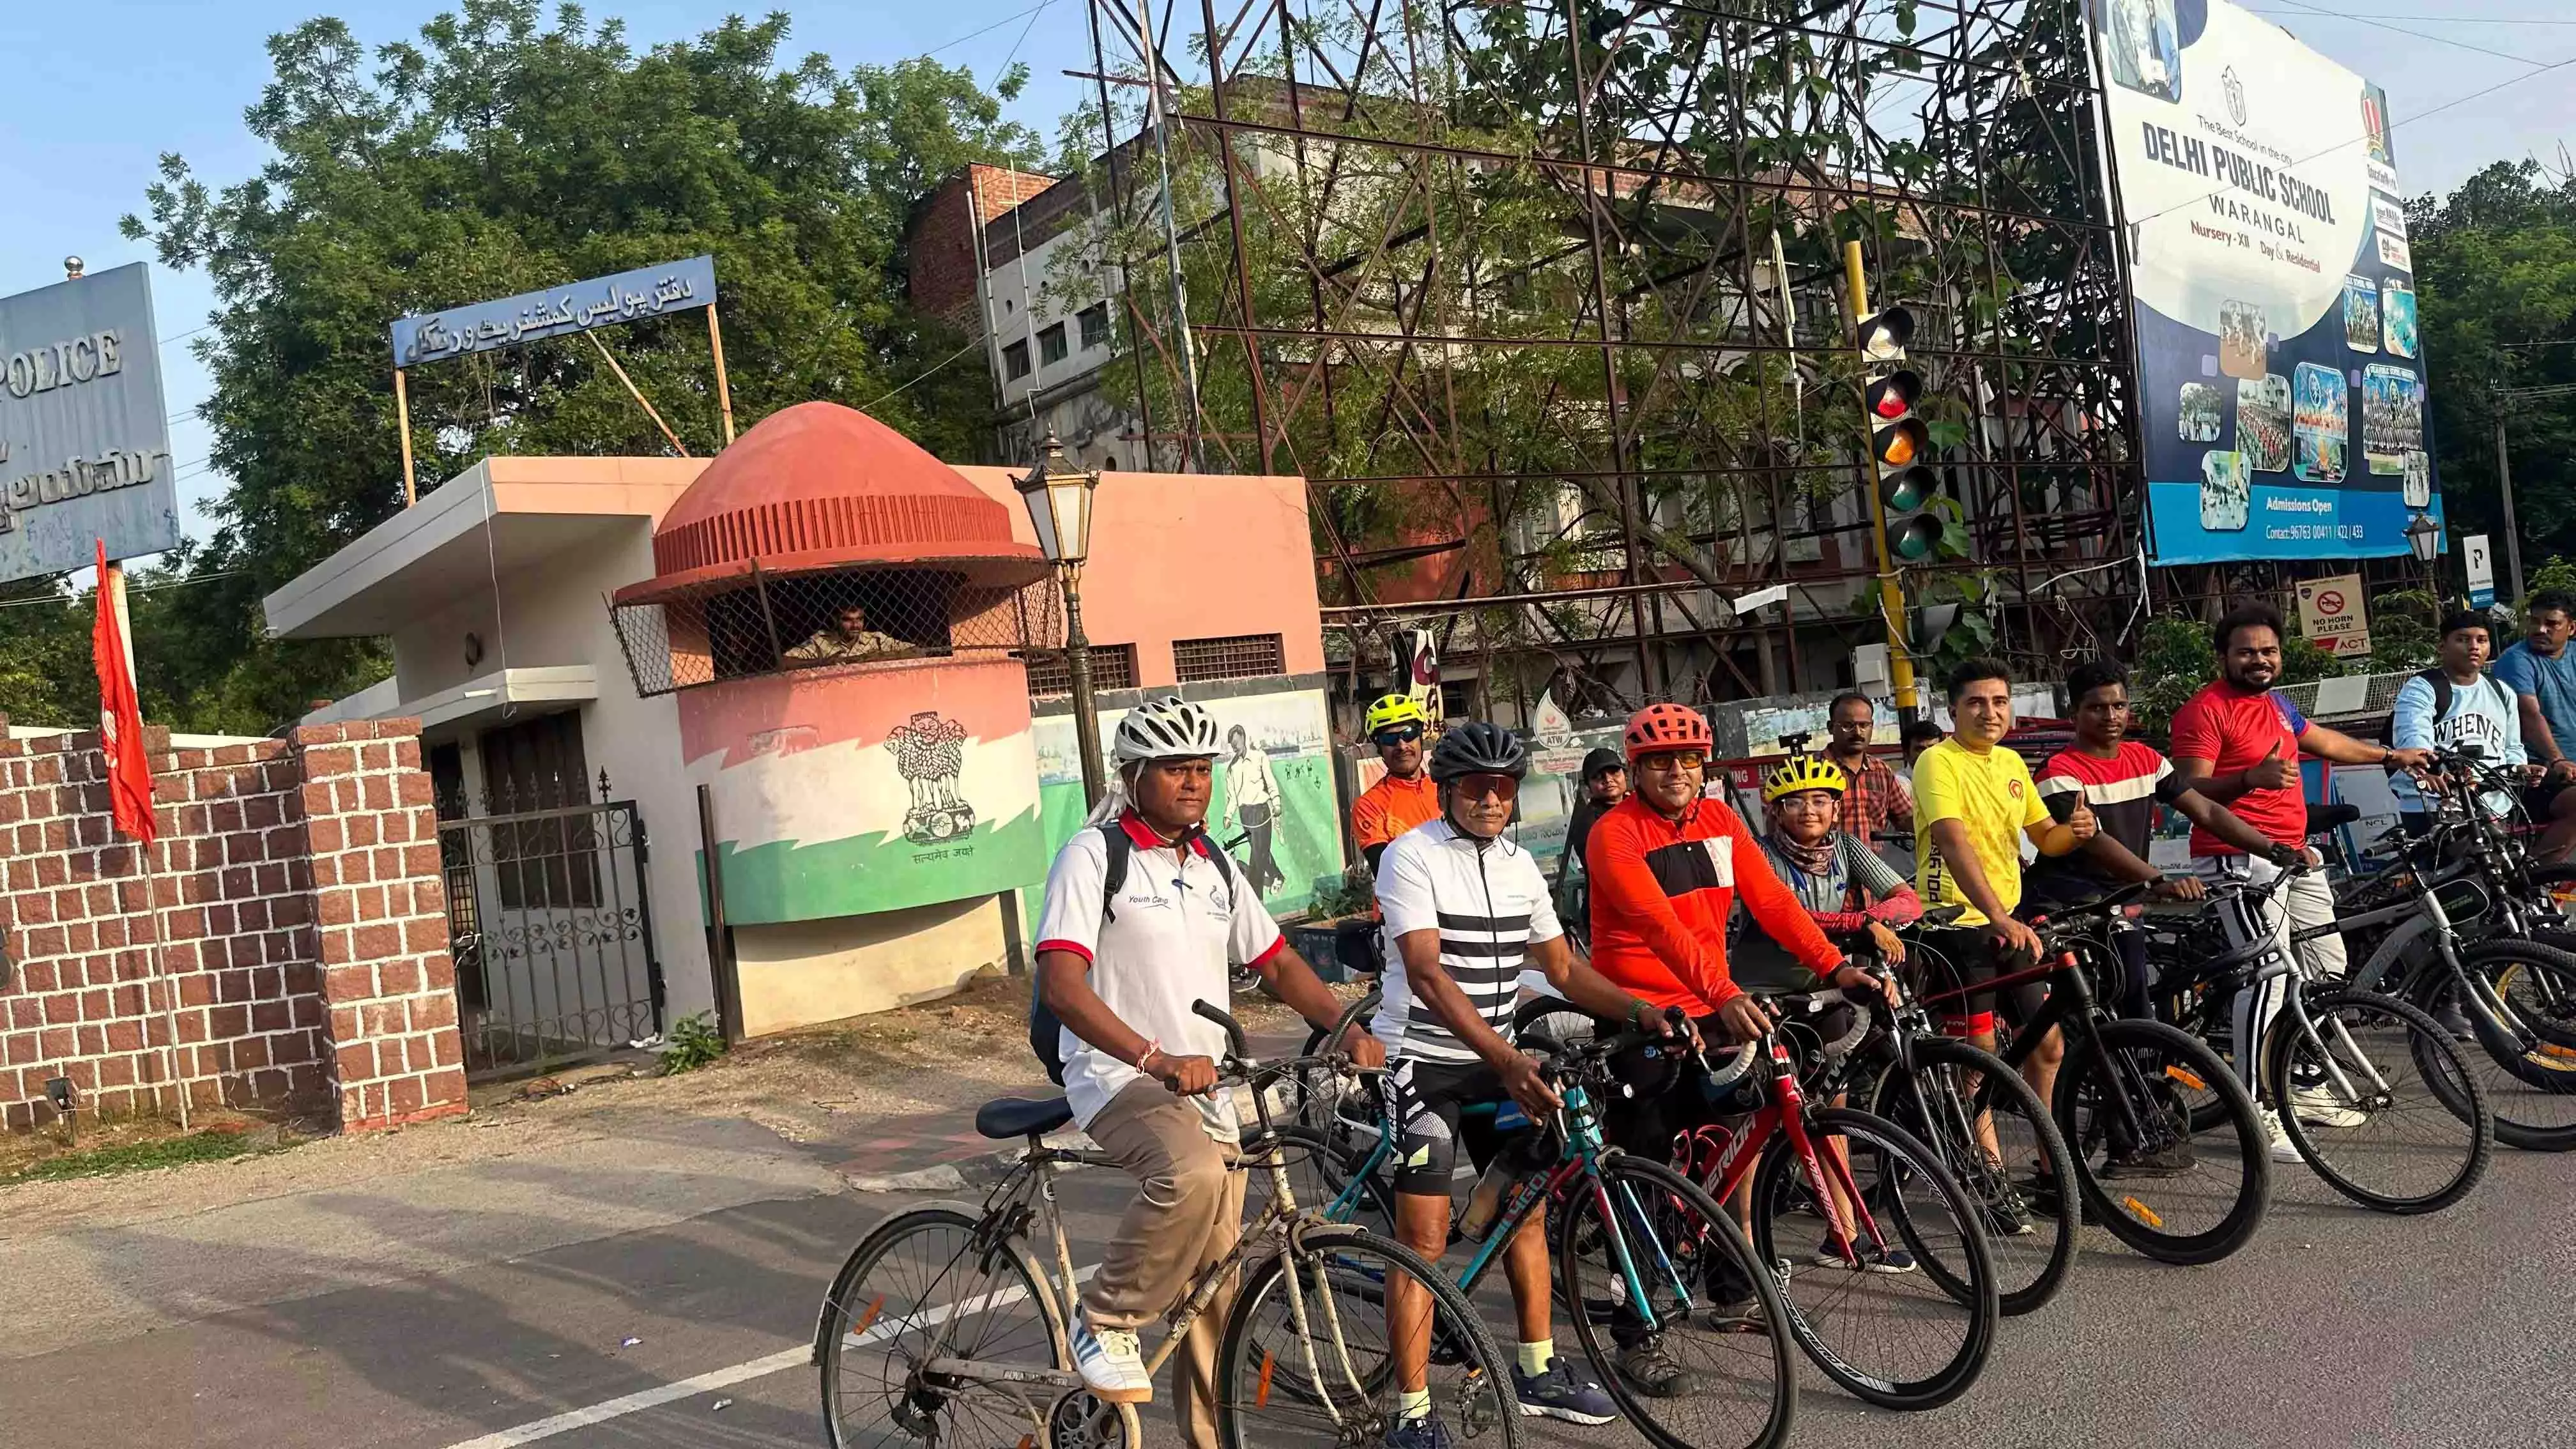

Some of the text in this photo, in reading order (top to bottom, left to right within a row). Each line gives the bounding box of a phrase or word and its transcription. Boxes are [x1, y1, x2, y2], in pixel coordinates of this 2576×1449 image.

[2196, 114, 2292, 167] The Best School in the city
[2142, 121, 2209, 176] DELHI
[2212, 145, 2276, 201] PUBLIC
[2278, 172, 2336, 225] SCHOOL
[2208, 194, 2305, 244] WARANGAL
[2260, 240, 2321, 273] Day & Residential
[2266, 496, 2332, 516] Admissions Open
[2352, 526, 2363, 539] 433
[2317, 623, 2352, 632] PLEASE
[2328, 615, 2354, 624] HORN
[2340, 638, 2367, 649] ACT
[1547, 735, 1563, 744] ATW
[912, 845, 975, 864] सत्यमेव जयते
[1129, 894, 1150, 903] Youth
[1701, 1113, 1756, 1195] ERIDA
[1804, 1155, 1843, 1235] MERIDA
